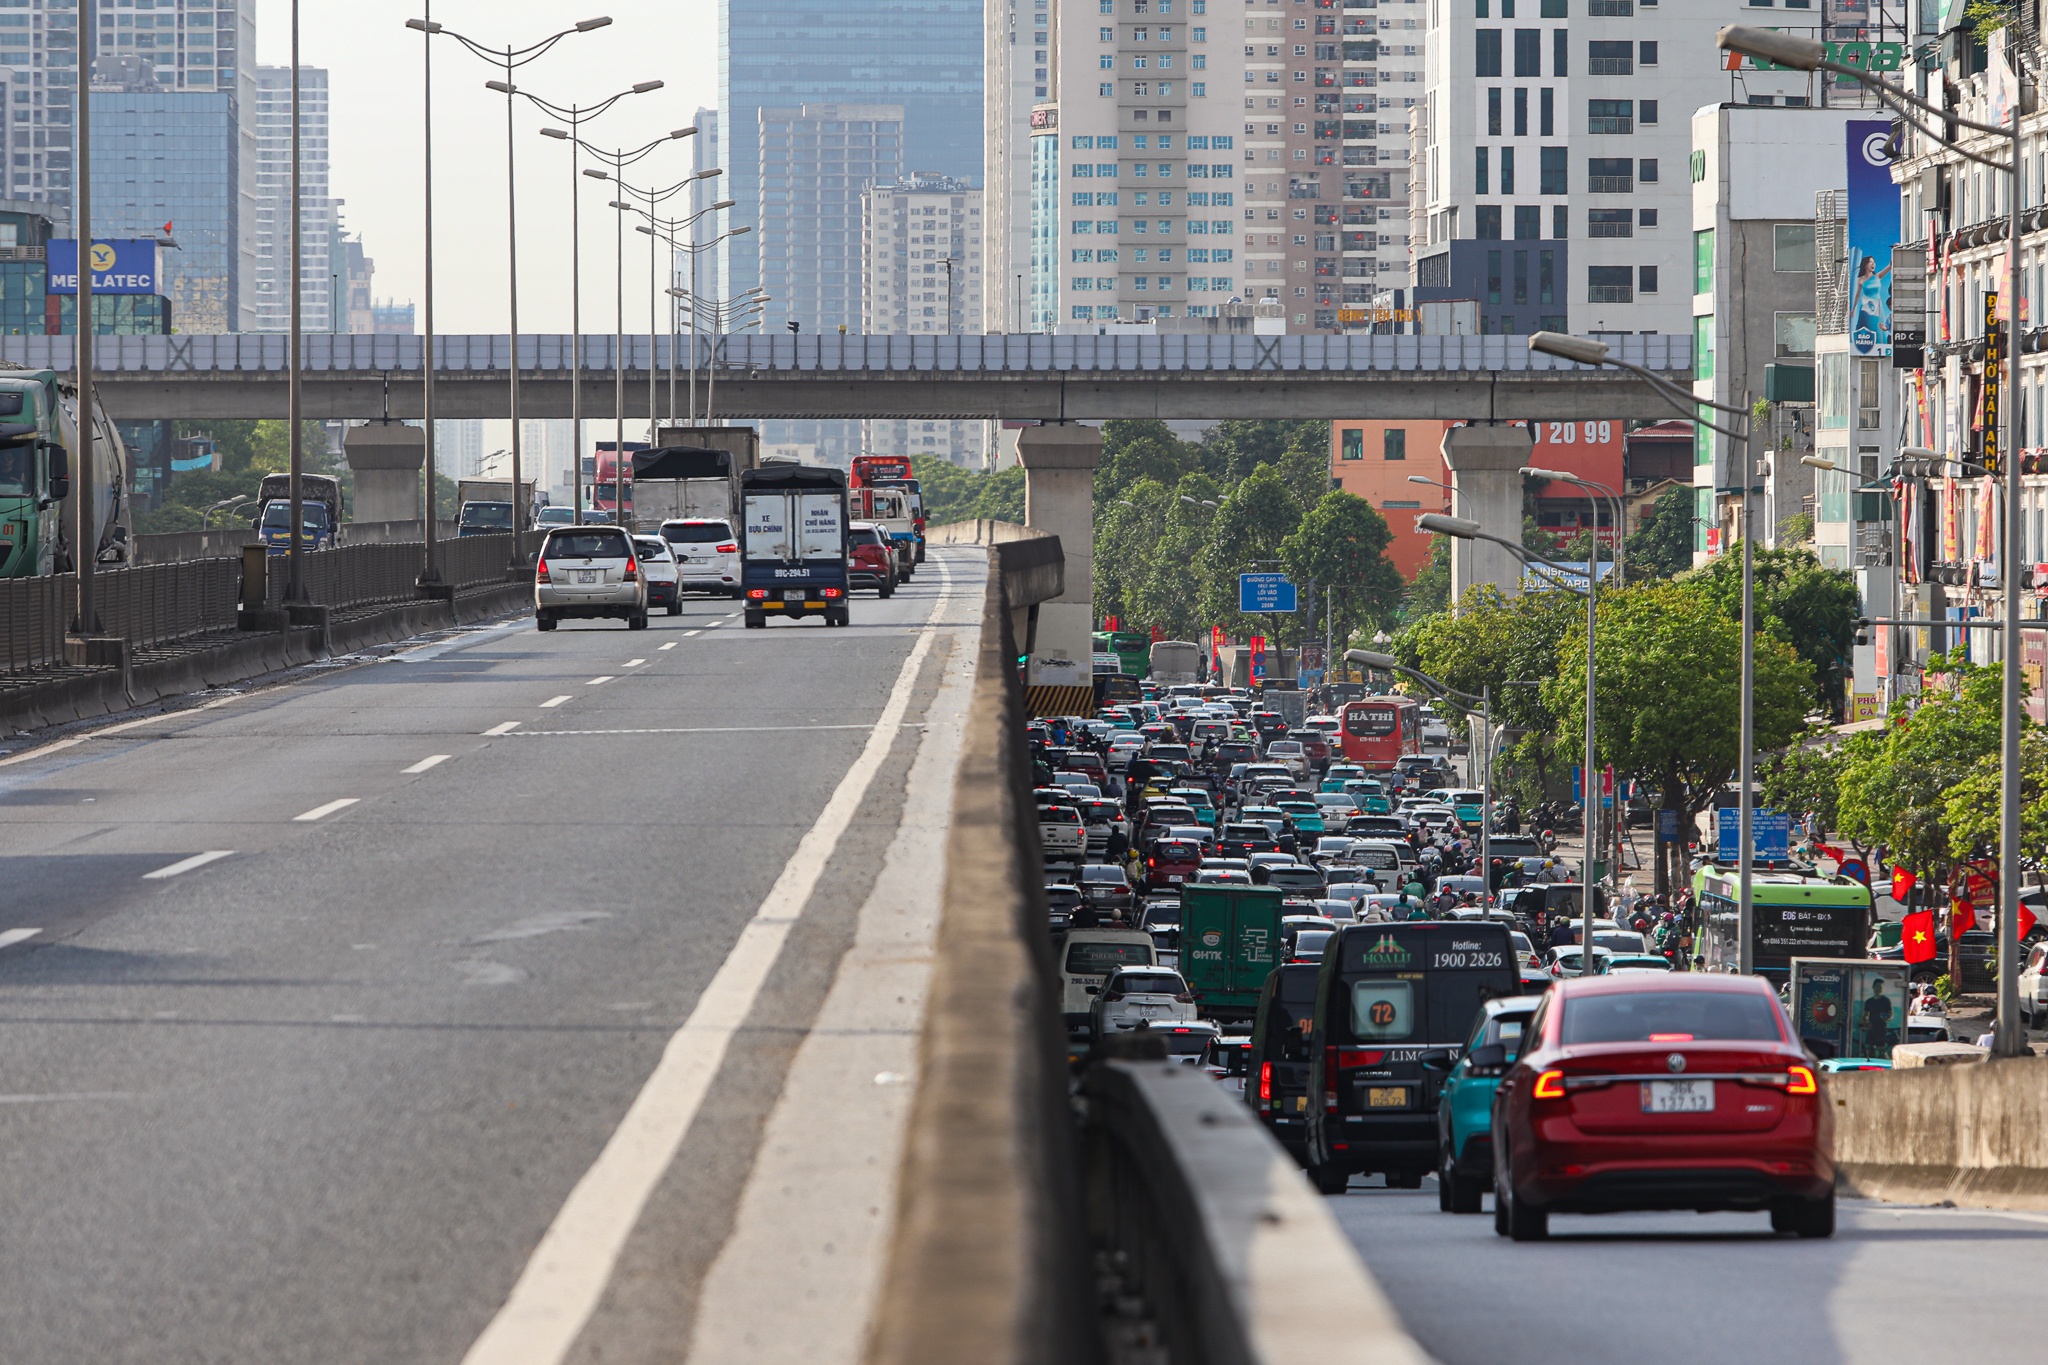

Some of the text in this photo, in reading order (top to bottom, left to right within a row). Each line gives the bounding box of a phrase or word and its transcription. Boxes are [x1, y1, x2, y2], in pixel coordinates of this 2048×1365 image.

[51, 274, 151, 288] MELATEC
[1985, 333, 1998, 378] THỜ
[1985, 384, 1997, 426] HẢI
[1550, 420, 1611, 444] 20 99
[1985, 431, 1997, 472] ANH
[3, 523, 15, 535] 01
[1857, 694, 1877, 704] PHỞ
[1860, 708, 1874, 716] GÀ
[1782, 911, 1797, 920] E06
[1452, 941, 1482, 950] Hotline:
[1193, 950, 1222, 960] GHTK
[1434, 952, 1502, 968] 1900 2826
[1372, 1004, 1393, 1023] 72
